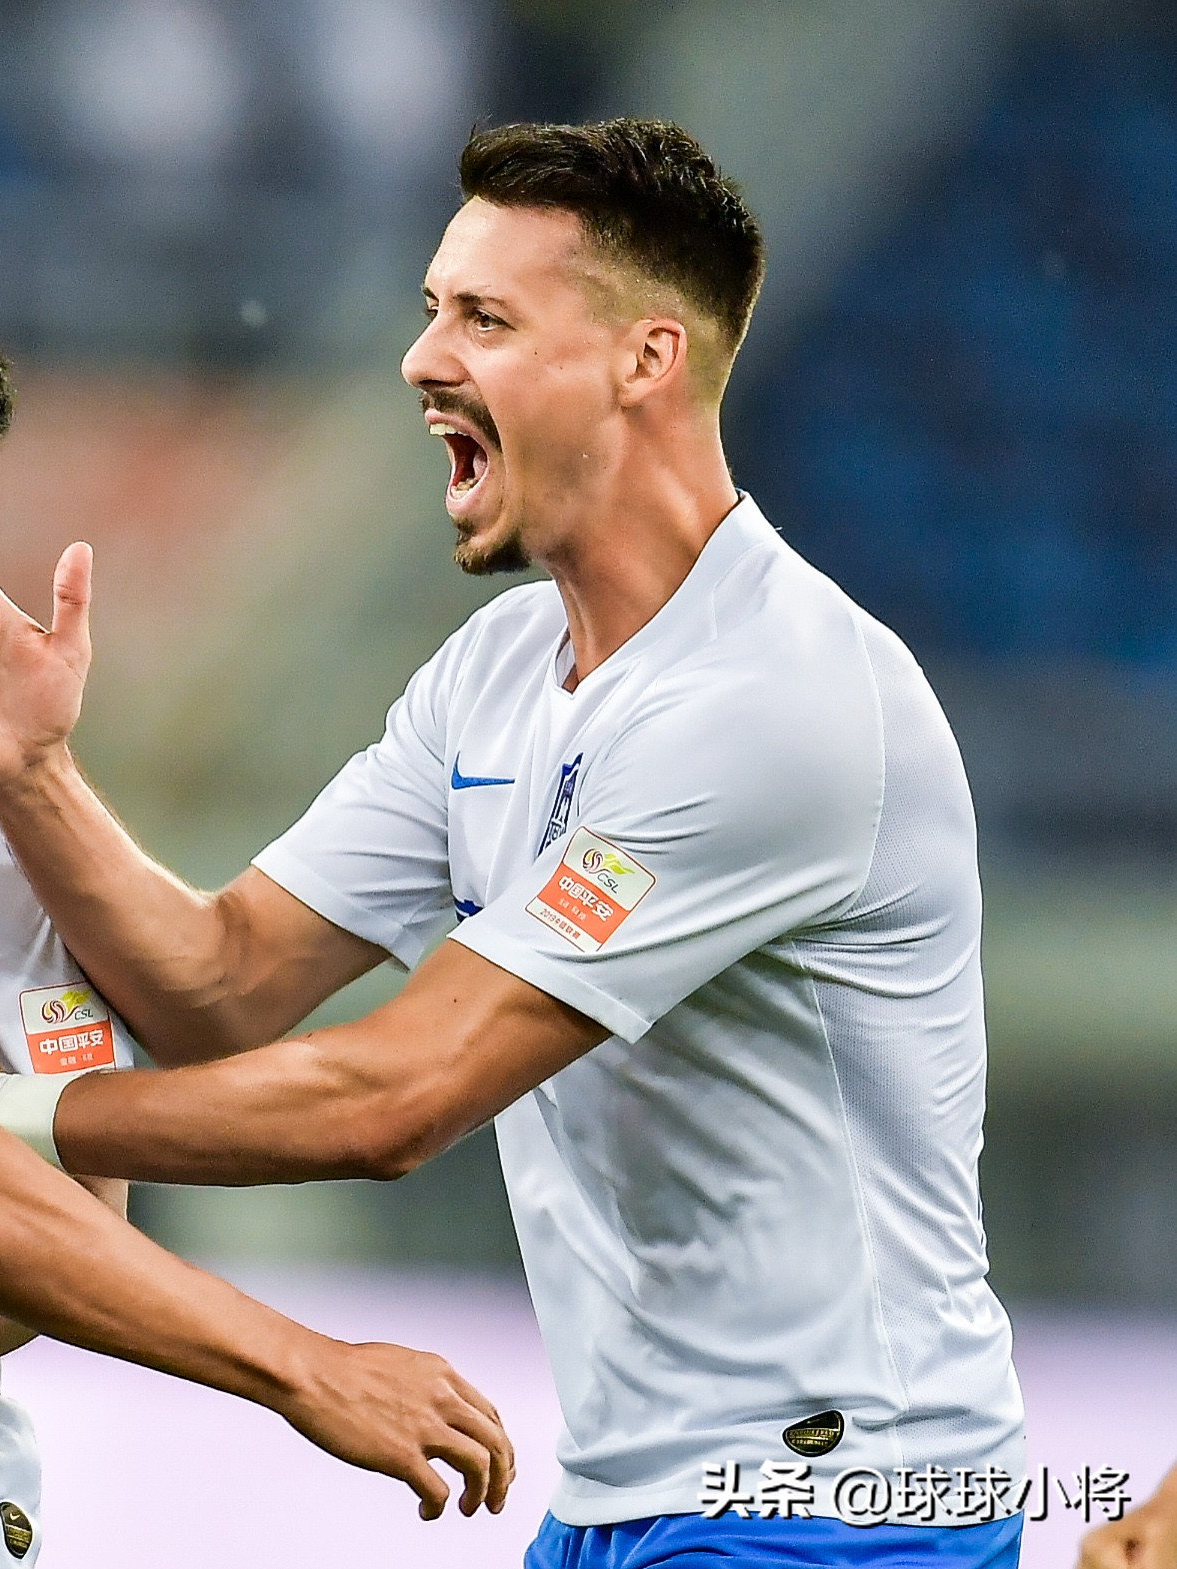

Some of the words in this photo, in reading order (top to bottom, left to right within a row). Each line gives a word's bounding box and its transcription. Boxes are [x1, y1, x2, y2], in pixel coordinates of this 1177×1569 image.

[597, 872, 617, 894] CSL
[558, 876, 614, 921] 中国平安
[74, 1009, 94, 1020] CSL
[39, 1029, 103, 1055] 中国平安
